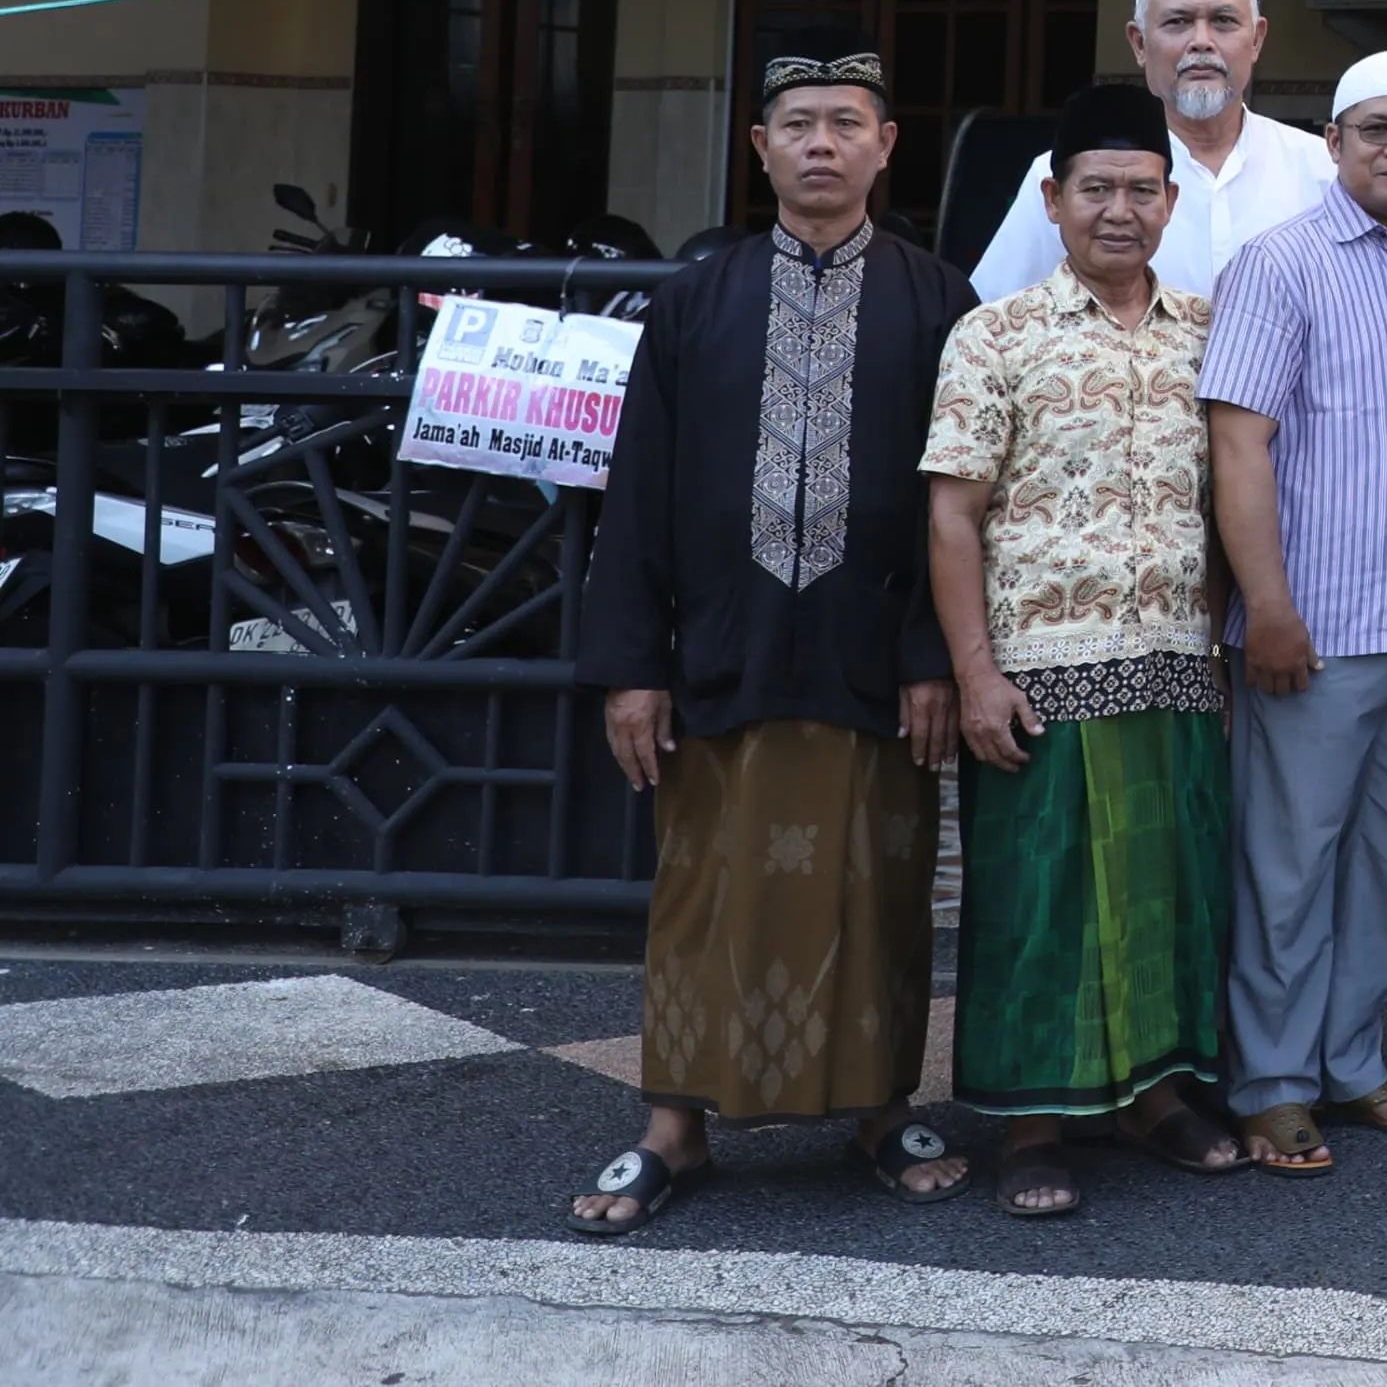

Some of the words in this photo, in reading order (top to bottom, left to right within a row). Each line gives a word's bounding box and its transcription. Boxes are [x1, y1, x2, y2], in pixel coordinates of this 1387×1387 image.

[0, 101, 70, 119] KURBAN
[453, 307, 488, 343] P
[491, 346, 566, 379] Mohon
[575, 358, 629, 386] Ma'a
[416, 367, 523, 423] PARKIR
[525, 385, 623, 437] KHUSU
[412, 417, 481, 450] Jama'ah
[488, 428, 544, 462] Masjid
[548, 437, 612, 475] At-Taqw
